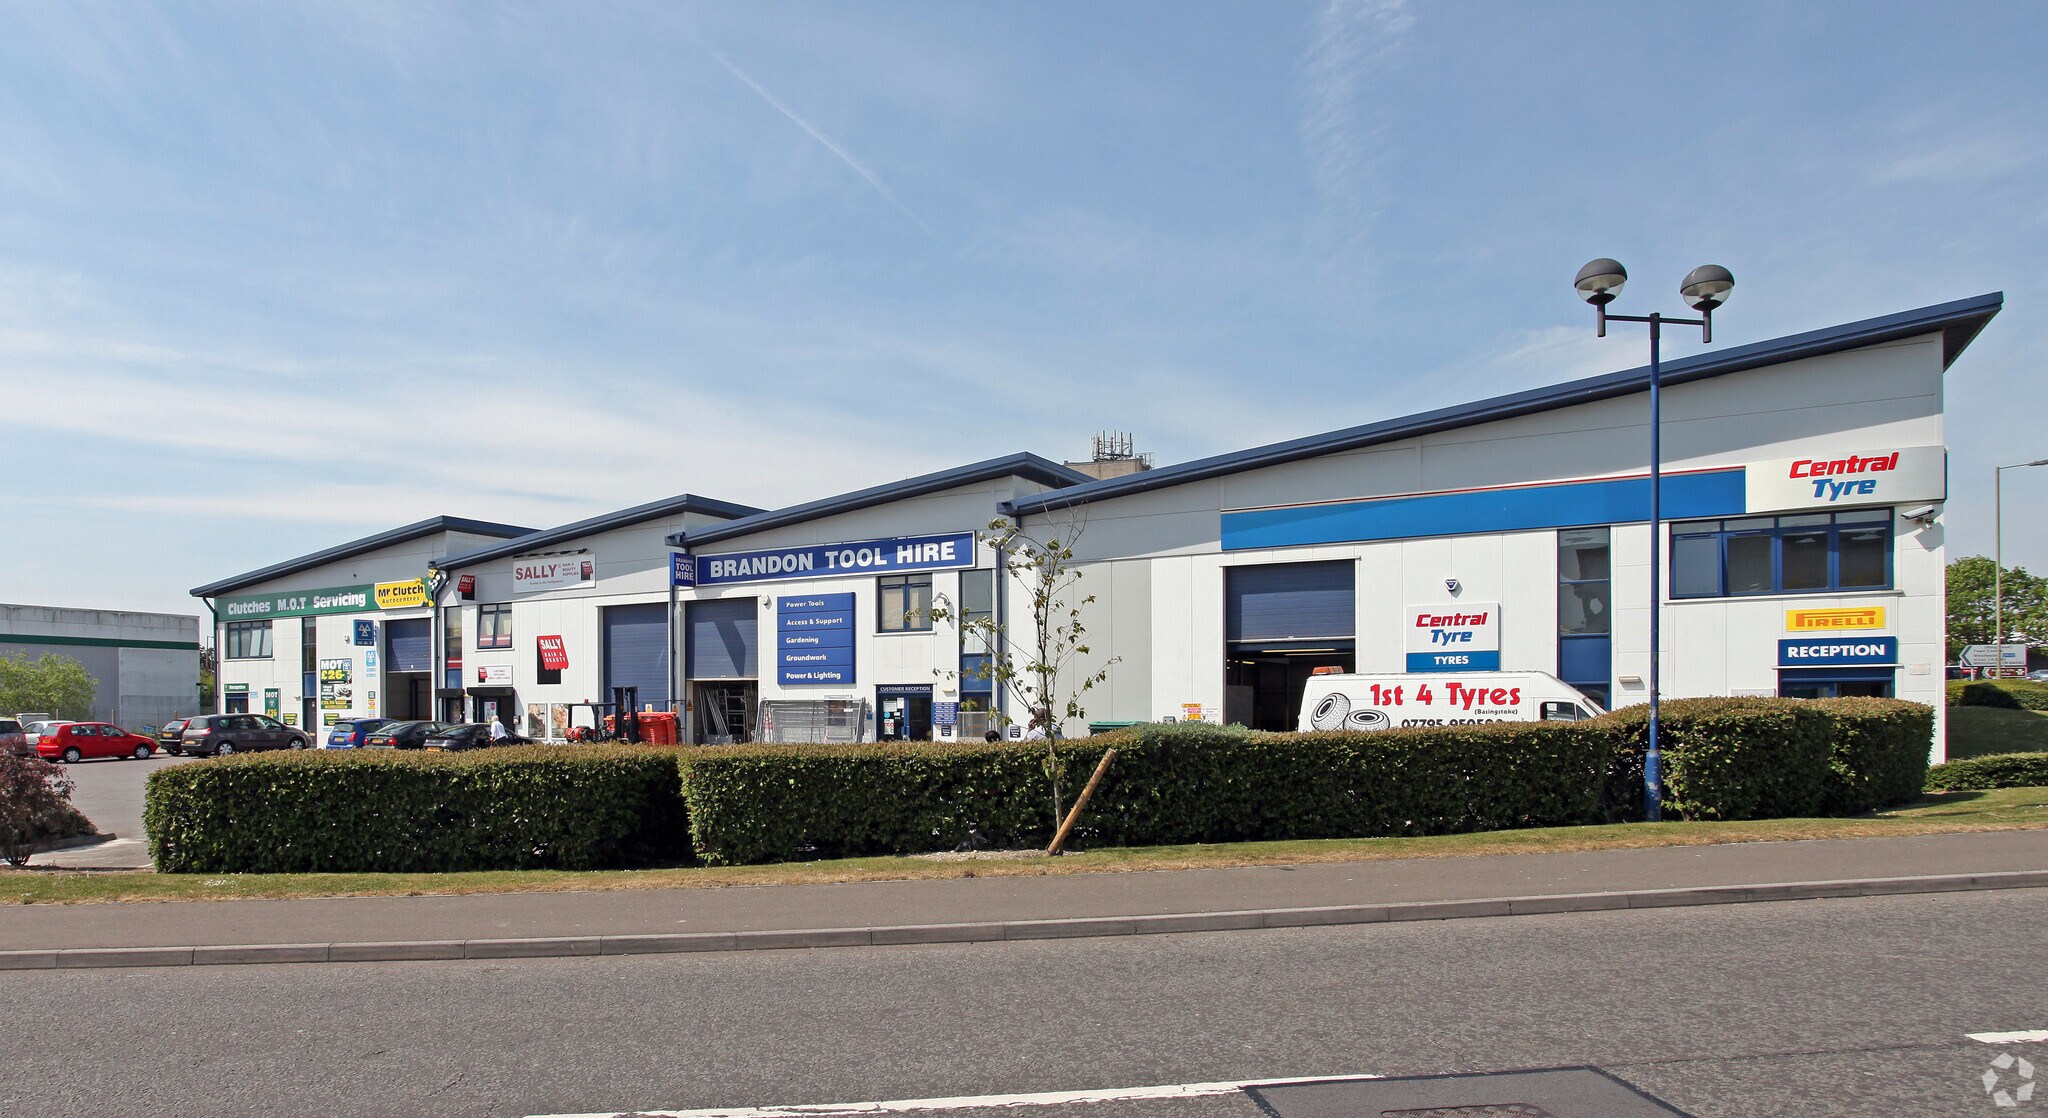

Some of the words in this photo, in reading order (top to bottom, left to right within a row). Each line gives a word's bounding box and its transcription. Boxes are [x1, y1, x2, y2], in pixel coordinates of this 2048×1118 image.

[1789, 452, 1899, 479] Central
[1811, 478, 1877, 501] Tyre
[710, 553, 813, 578] BRANDON
[825, 547, 887, 569] TOOL
[896, 541, 956, 564] HIRE
[515, 564, 558, 580] SALLY
[675, 563, 694, 572] TOOL
[675, 571, 694, 580] HIRE
[378, 588, 391, 598] Mr
[392, 585, 424, 596] Clutch
[228, 601, 271, 615] Clutches
[277, 597, 307, 611] M.O.T
[313, 592, 366, 609] Servicing
[382, 596, 420, 604] Autocentres
[815, 617, 843, 625] Support
[1416, 612, 1488, 628] Central
[1796, 611, 1876, 627] PIRELLI
[786, 636, 819, 644] Gardening
[1431, 629, 1473, 646] Tyre
[540, 638, 561, 650] SALLY
[1787, 644, 1885, 658] RECEPTION
[786, 654, 827, 662] Groundwork
[1433, 655, 1469, 665] TYRES
[320, 659, 343, 670] MOT
[813, 671, 841, 680] Lighting
[1370, 684, 1404, 706] 1st
[1416, 684, 1433, 706] 4
[1445, 682, 1521, 711] Tyres
[1474, 708, 1518, 716] (Basingstoke)
